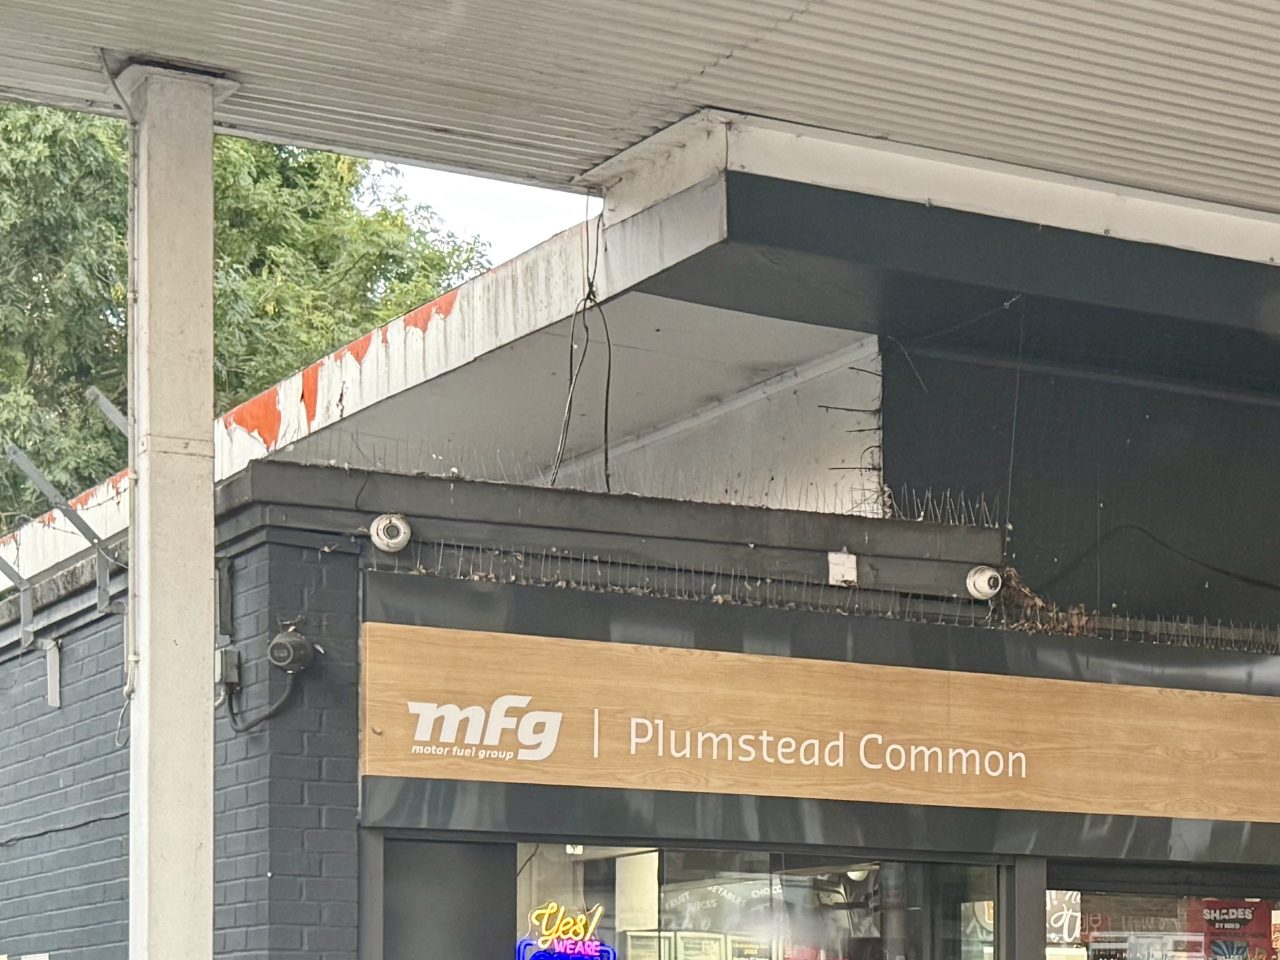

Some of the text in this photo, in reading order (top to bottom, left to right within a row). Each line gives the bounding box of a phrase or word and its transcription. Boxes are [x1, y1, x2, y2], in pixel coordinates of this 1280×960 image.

[407, 695, 563, 761] mfg
[629, 717, 1027, 778] Plumstead Common
[411, 745, 514, 760] motor fuel group
[532, 902, 604, 948] Yes!
[1202, 907, 1253, 921] SHADES
